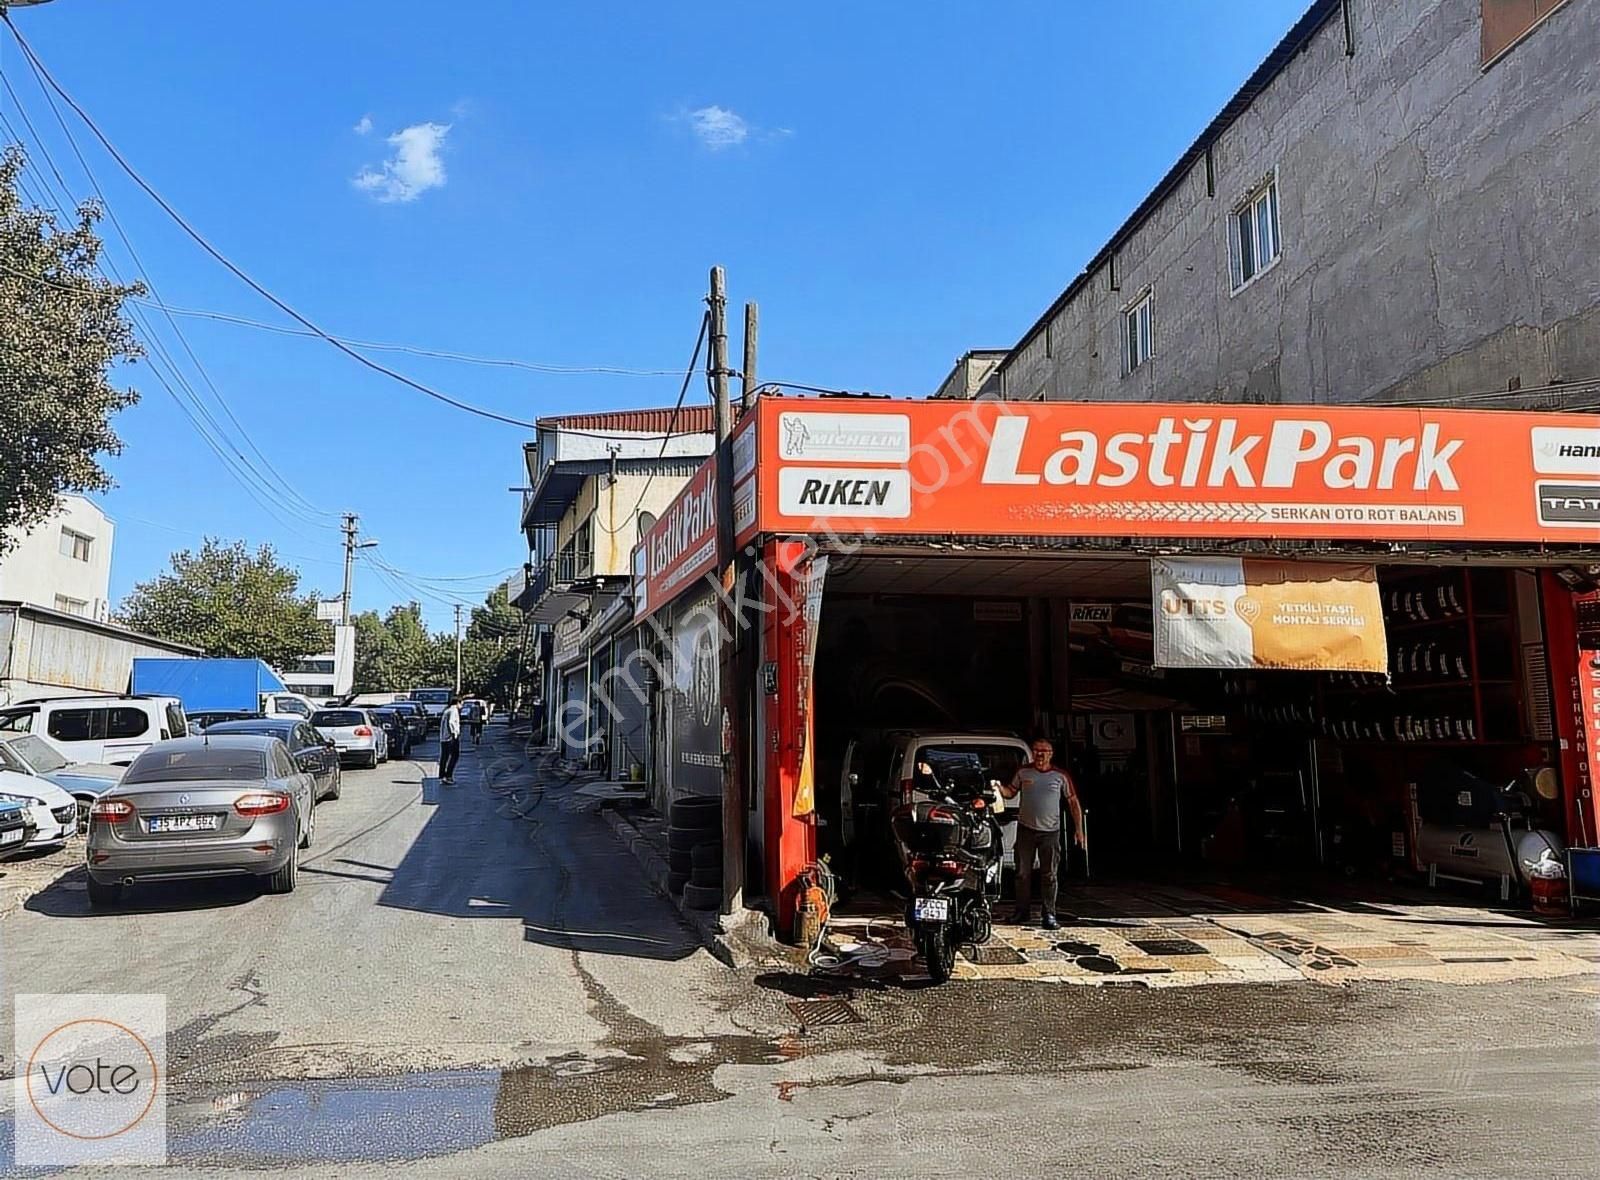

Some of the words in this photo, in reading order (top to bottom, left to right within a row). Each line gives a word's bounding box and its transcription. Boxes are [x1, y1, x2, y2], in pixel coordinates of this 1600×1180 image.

[813, 432, 902, 447] MICHELIN
[1271, 507, 1331, 521] SERKAN
[1335, 508, 1364, 521] OTO
[1368, 509, 1396, 521] ROT
[1399, 509, 1457, 522] BALANS
[1165, 598, 1227, 615] UTTS
[1272, 614, 1320, 625] MONTAJ
[1570, 676, 1587, 753] SERKAN
[1578, 761, 1591, 799] OTO
